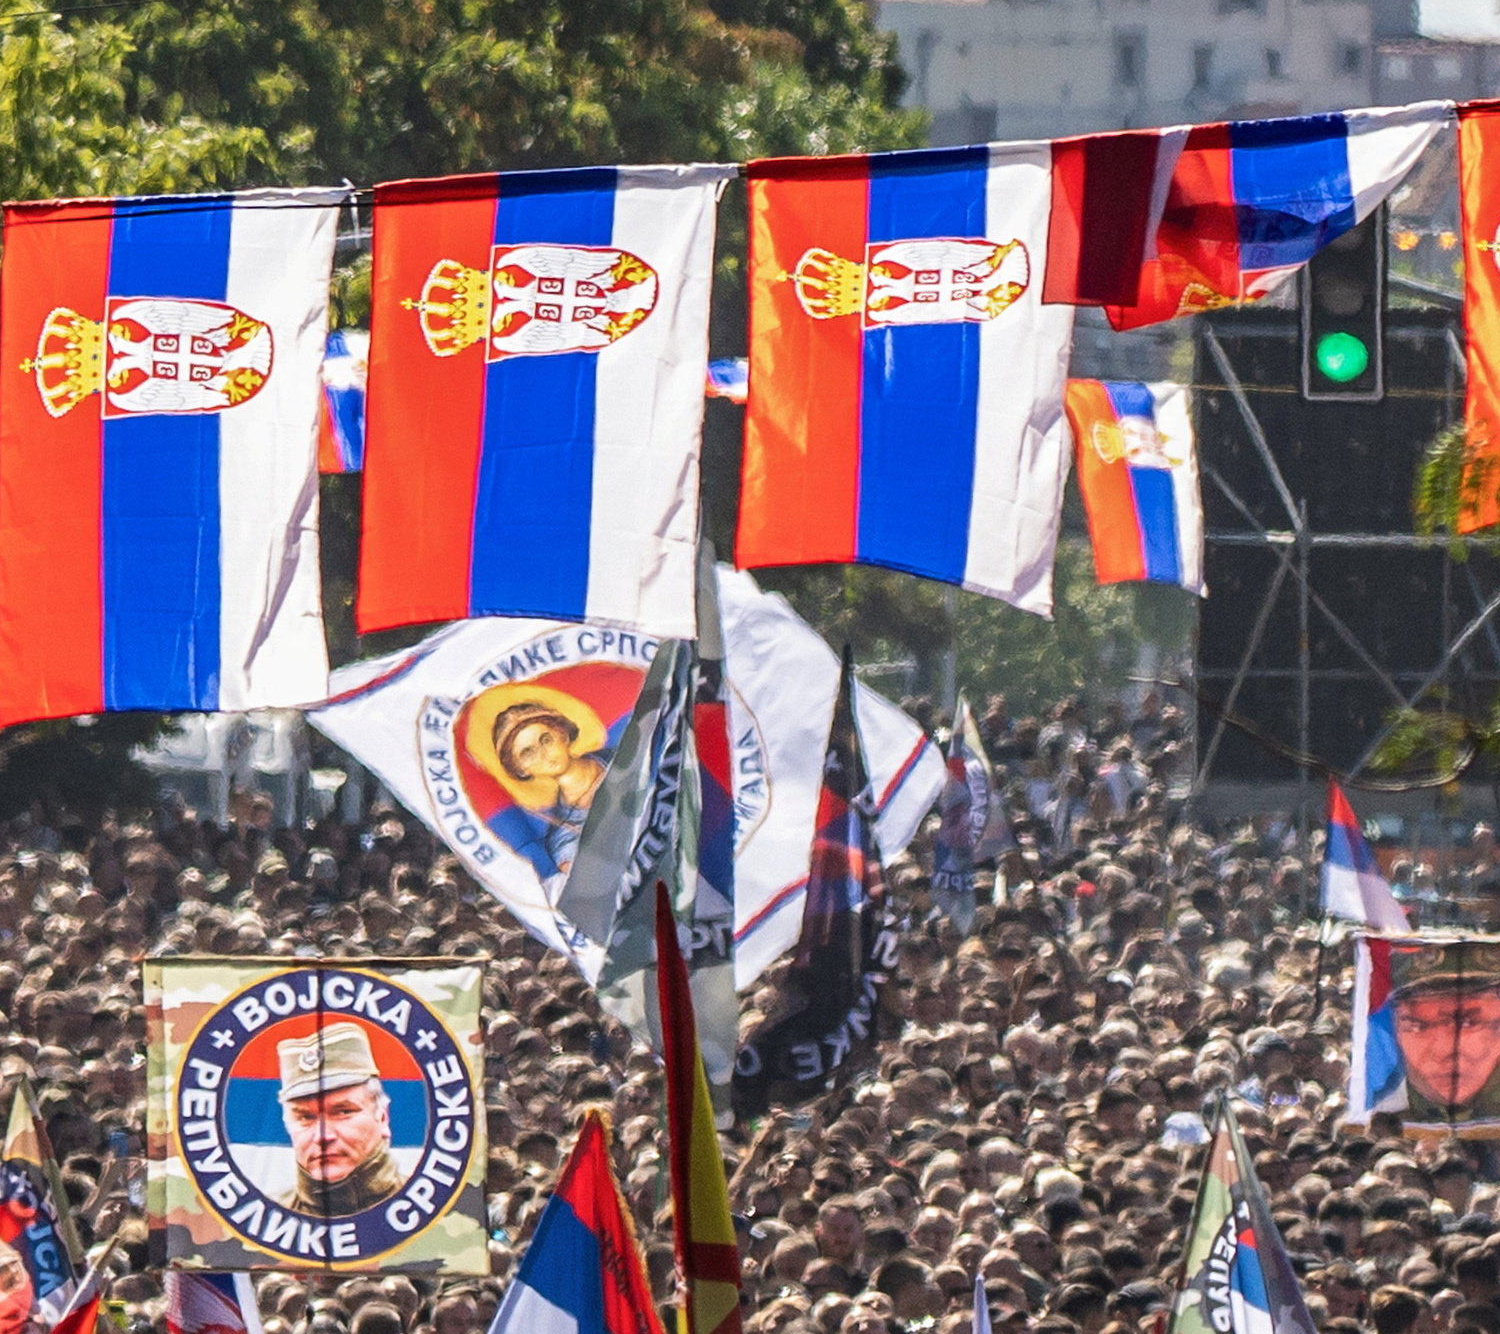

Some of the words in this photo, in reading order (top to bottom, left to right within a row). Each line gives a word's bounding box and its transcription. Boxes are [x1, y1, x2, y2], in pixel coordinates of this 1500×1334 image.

[232, 975, 413, 1036] ВОЈСКА
[180, 1057, 360, 1259] РЕПУБЛИКЕ
[385, 1054, 471, 1233] СРПСКЕ
